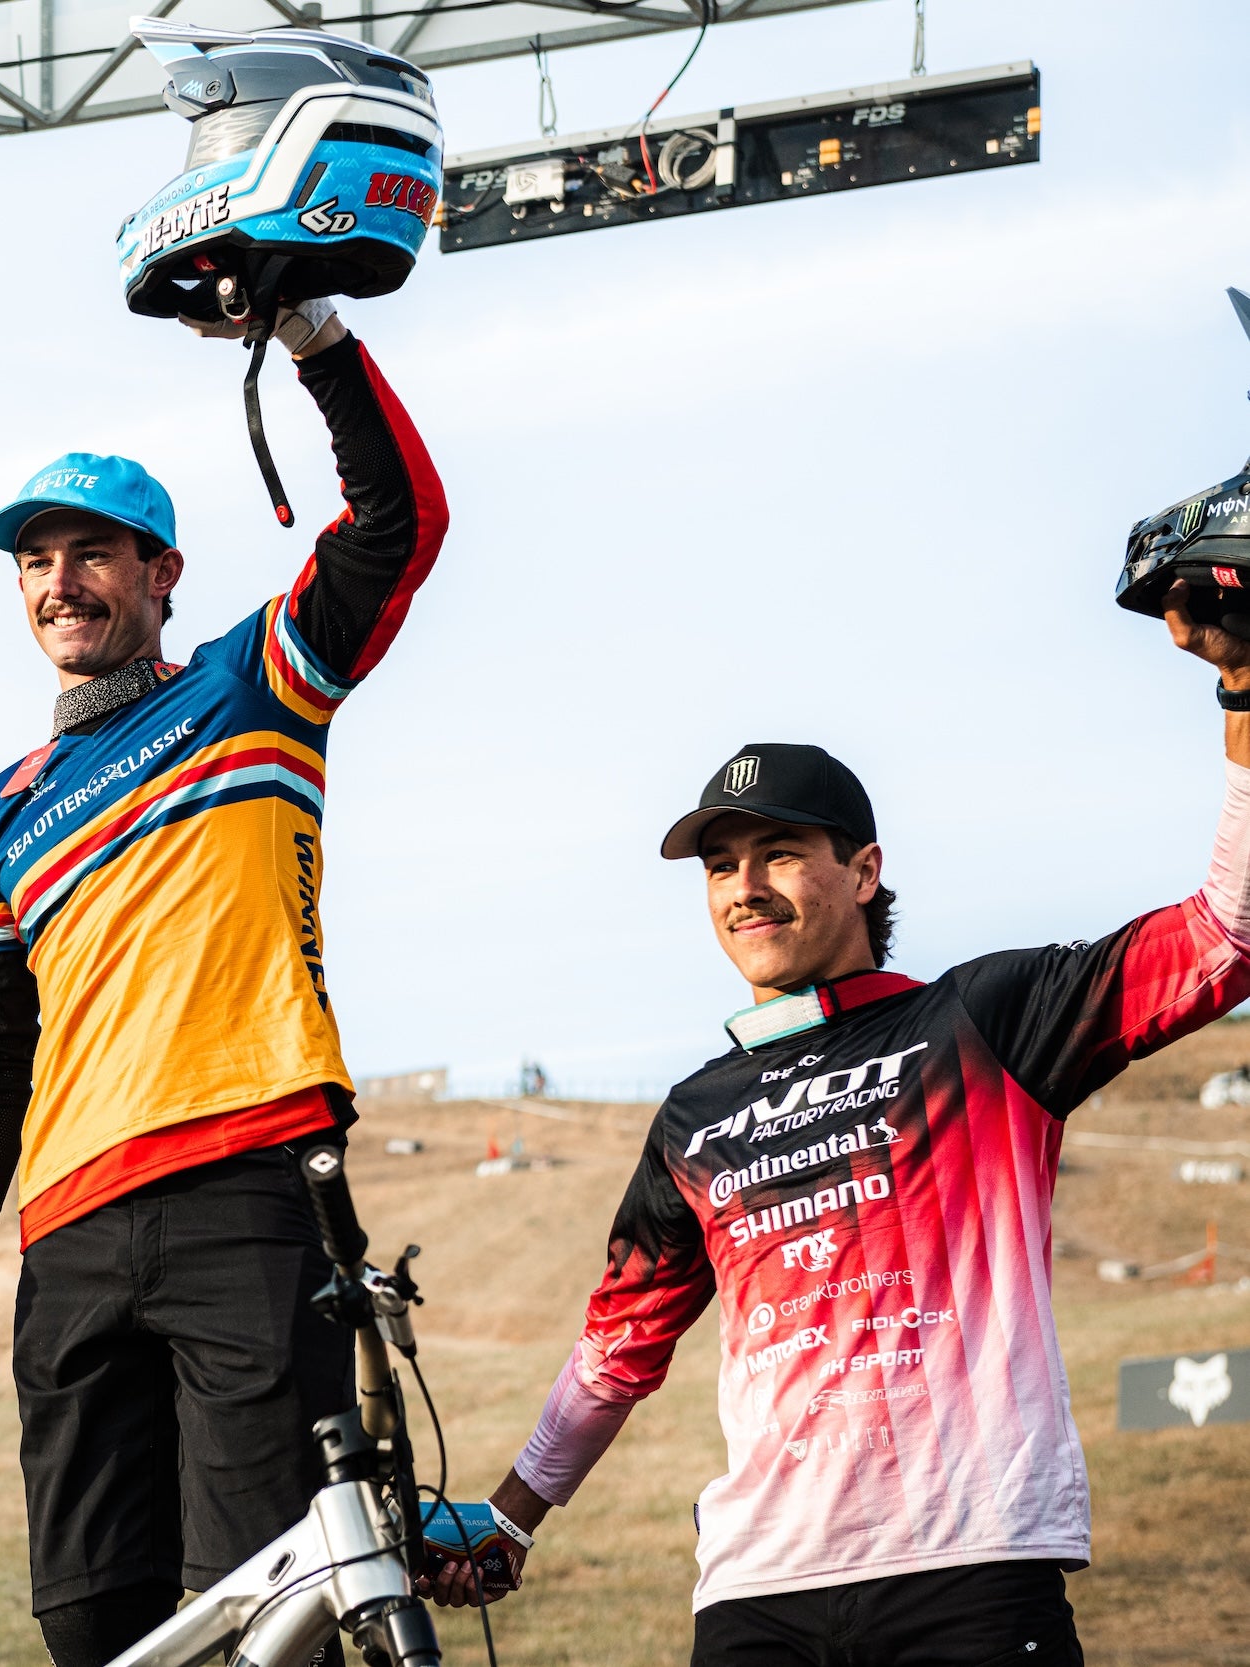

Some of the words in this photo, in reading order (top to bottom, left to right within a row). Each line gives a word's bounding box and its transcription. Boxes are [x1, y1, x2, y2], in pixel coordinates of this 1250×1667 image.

[852, 102, 906, 126] FDS
[140, 184, 231, 262] RE-LYTE
[32, 474, 100, 498] RE-LYTE
[1230, 515, 1250, 524] AR
[6, 833, 35, 868] SEA
[34, 788, 90, 838] OTTER
[115, 717, 196, 780] CLASSIC
[683, 1041, 929, 1159] PIVOT
[748, 1103, 831, 1144] FACTORY
[828, 1079, 900, 1114] RACING
[708, 1123, 871, 1209] Continental
[728, 1173, 890, 1248] SHIMANO
[780, 1228, 839, 1272] FOX
[779, 1267, 915, 1317] crankbrothers
[851, 1307, 955, 1333] FIDLOCK
[849, 1348, 926, 1373] SPORT
[500, 1519, 522, 1539] 4-Day
